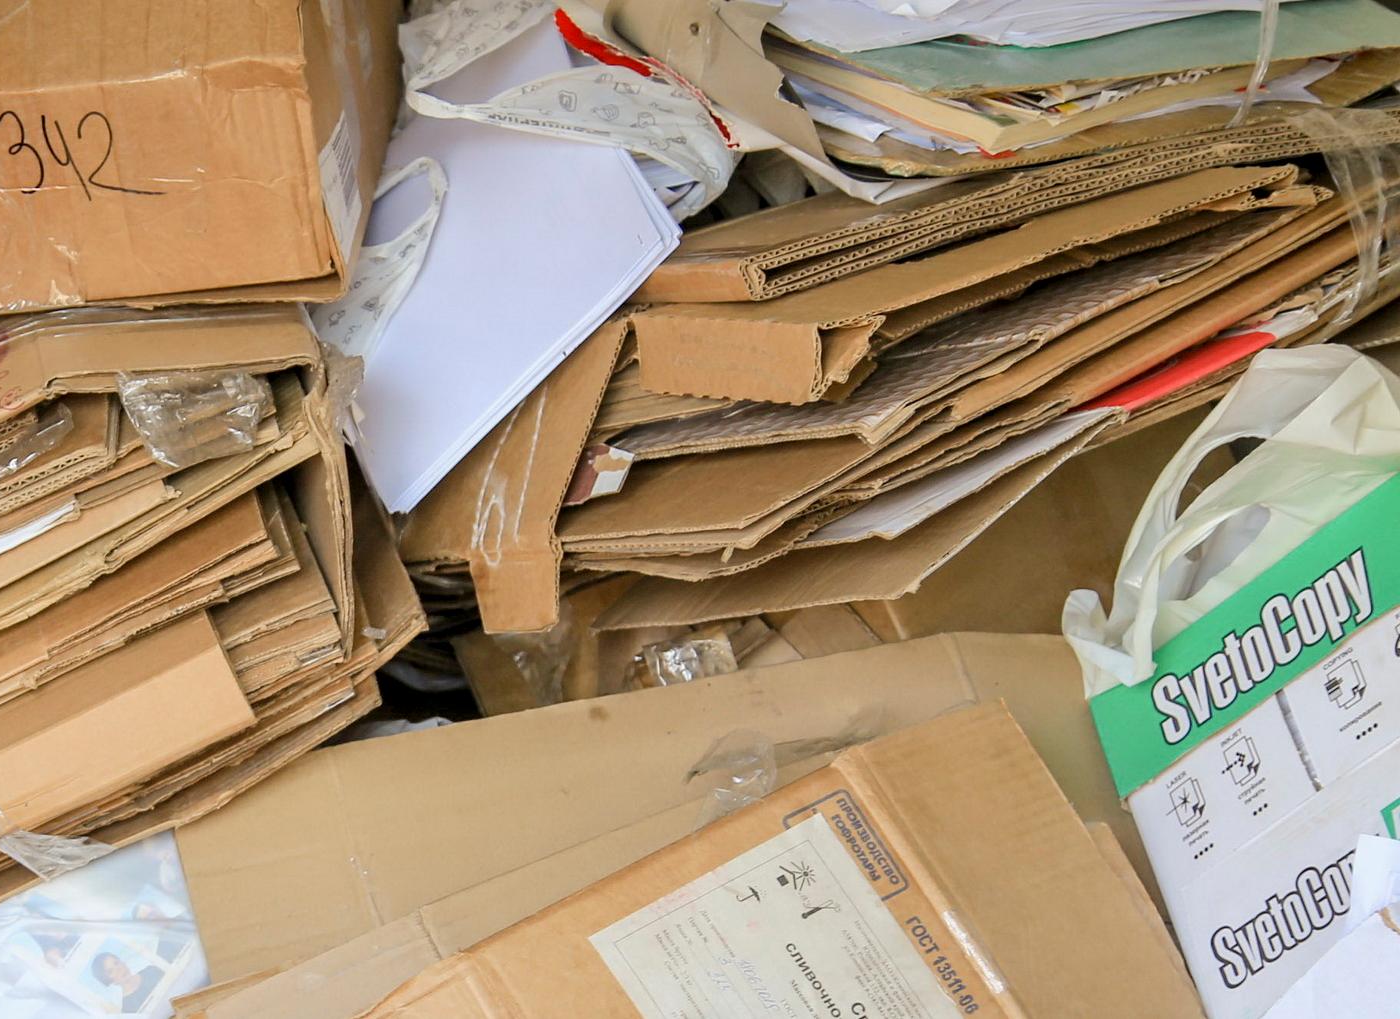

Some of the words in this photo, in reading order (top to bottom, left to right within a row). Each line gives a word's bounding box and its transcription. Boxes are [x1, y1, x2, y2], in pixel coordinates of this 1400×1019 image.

[1151, 546, 1374, 746] SvetoCopy
[1166, 771, 1187, 789] LASER
[832, 814, 881, 882] ГОФРОТАРЫ
[836, 798, 900, 885] ПРОИЗВОДСТВО
[905, 915, 941, 956] ГОСТ
